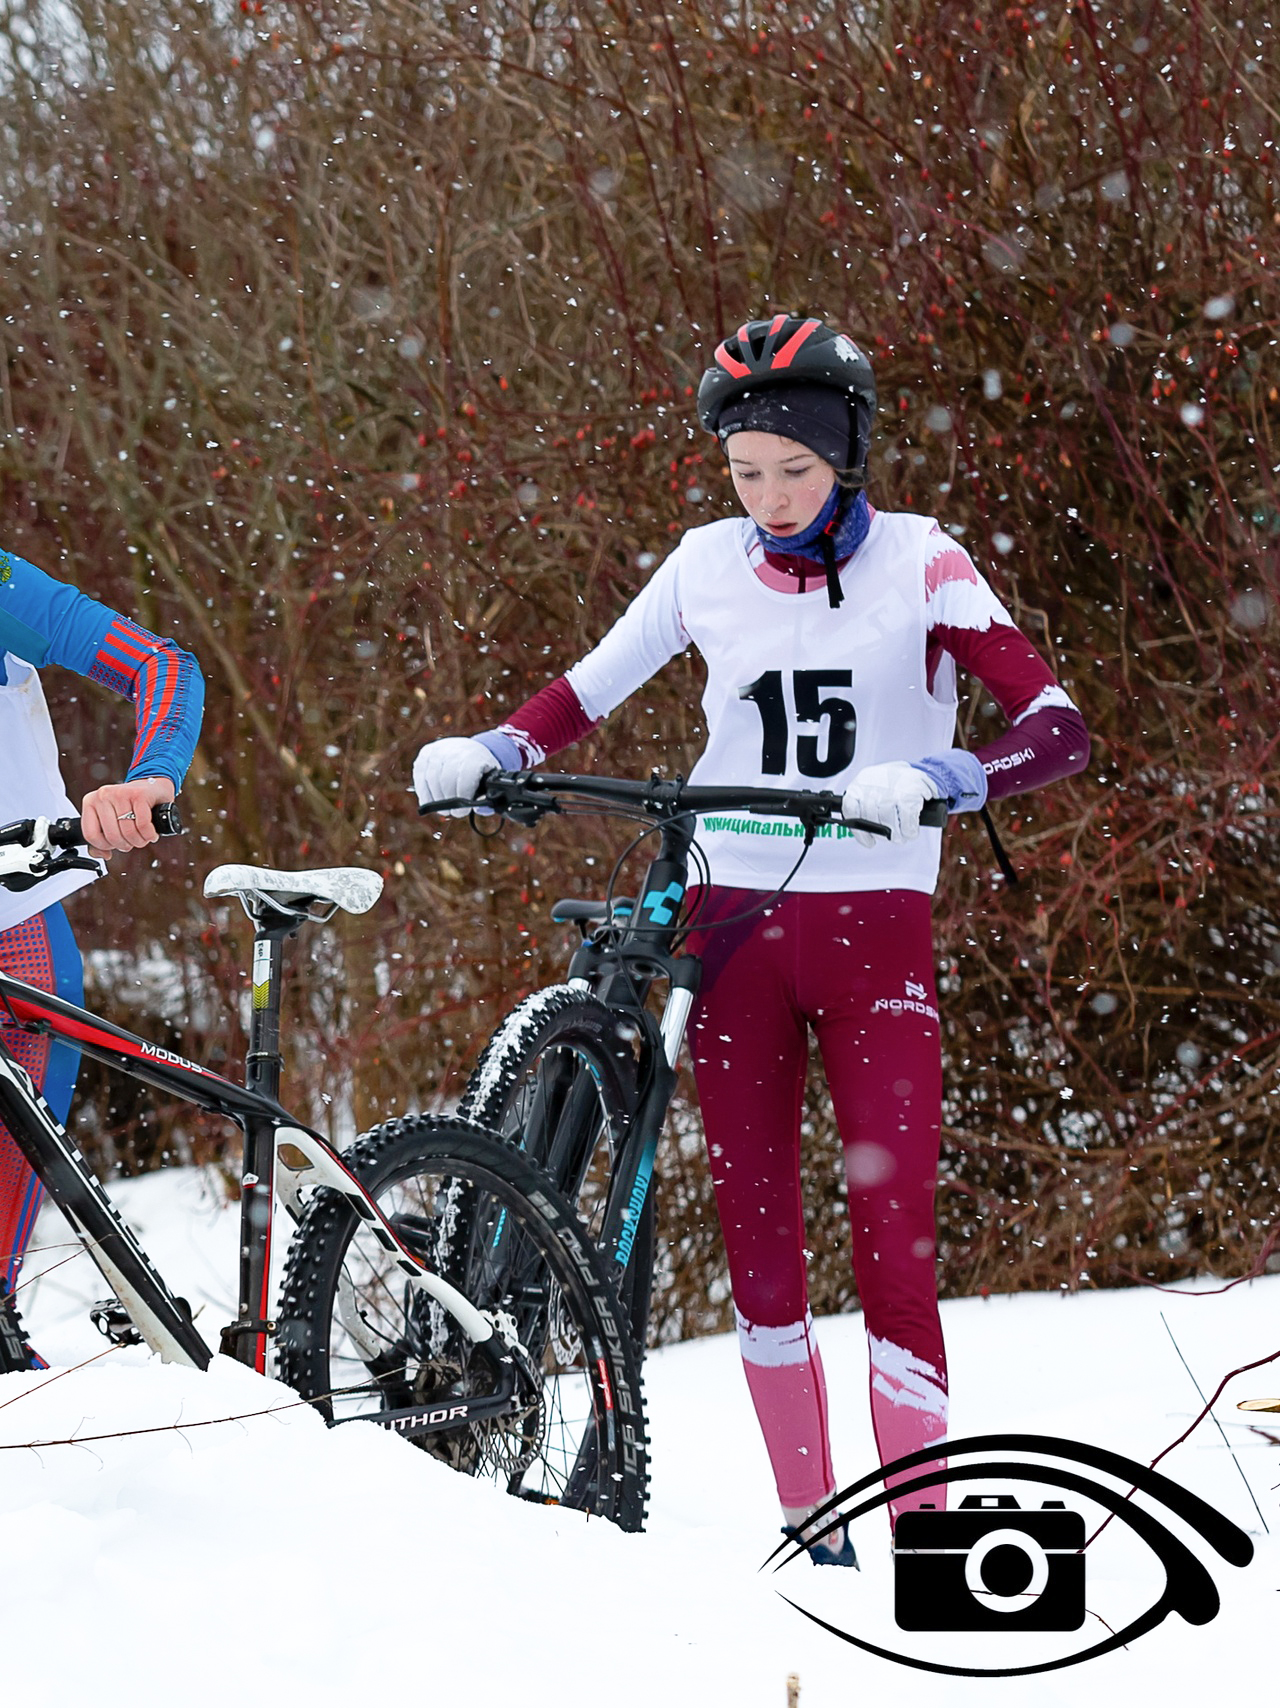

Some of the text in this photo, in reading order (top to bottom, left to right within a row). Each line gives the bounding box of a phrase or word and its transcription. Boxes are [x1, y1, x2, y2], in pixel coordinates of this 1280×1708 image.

[738, 669, 857, 778] 15
[982, 746, 1036, 776] ORDSKI
[140, 1041, 203, 1074] MODUS
[556, 1225, 601, 1287] PRO
[592, 1295, 636, 1415] SPIKER
[381, 1405, 469, 1431] UTHOR
[624, 1423, 638, 1477] ICE
